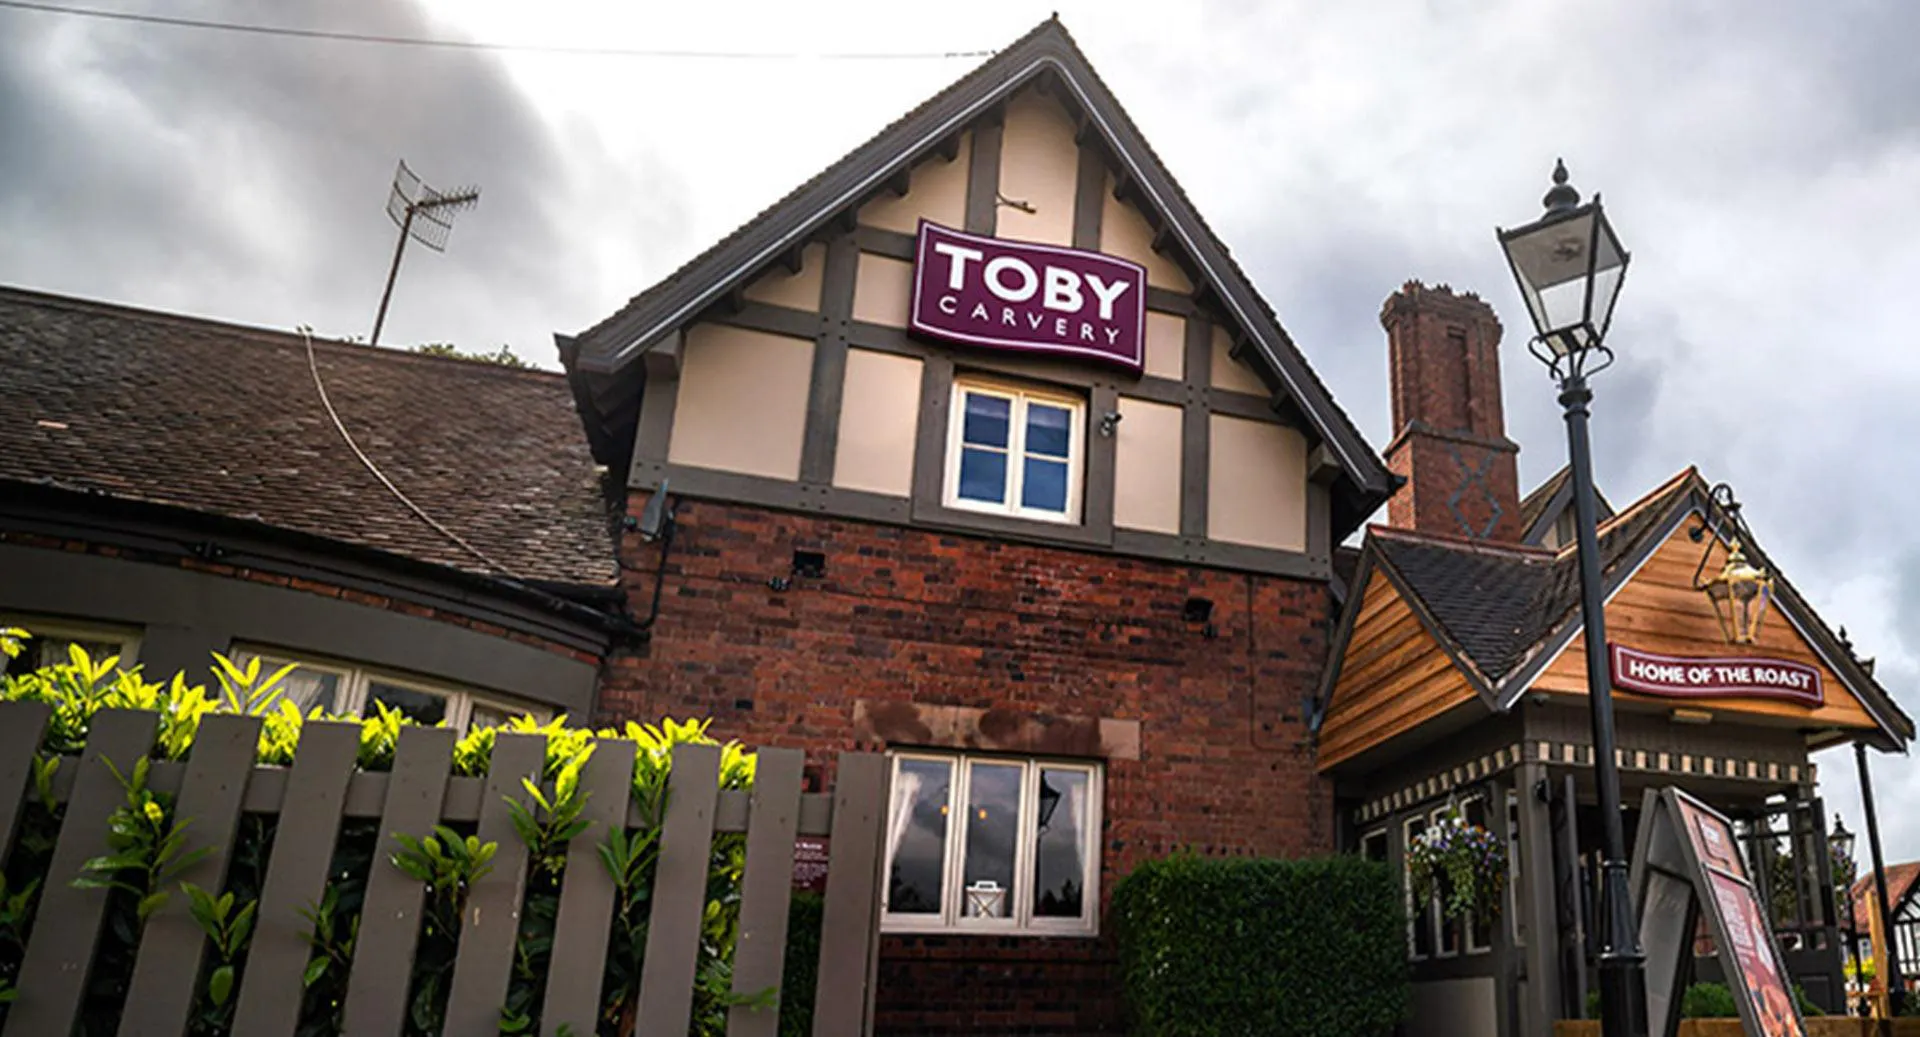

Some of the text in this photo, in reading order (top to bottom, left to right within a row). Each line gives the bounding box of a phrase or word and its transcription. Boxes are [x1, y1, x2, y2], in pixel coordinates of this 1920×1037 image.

[935, 243, 1130, 320] TOBY
[938, 295, 1120, 345] CARVERY
[1629, 660, 1811, 689] HOME OF THE ROAST
